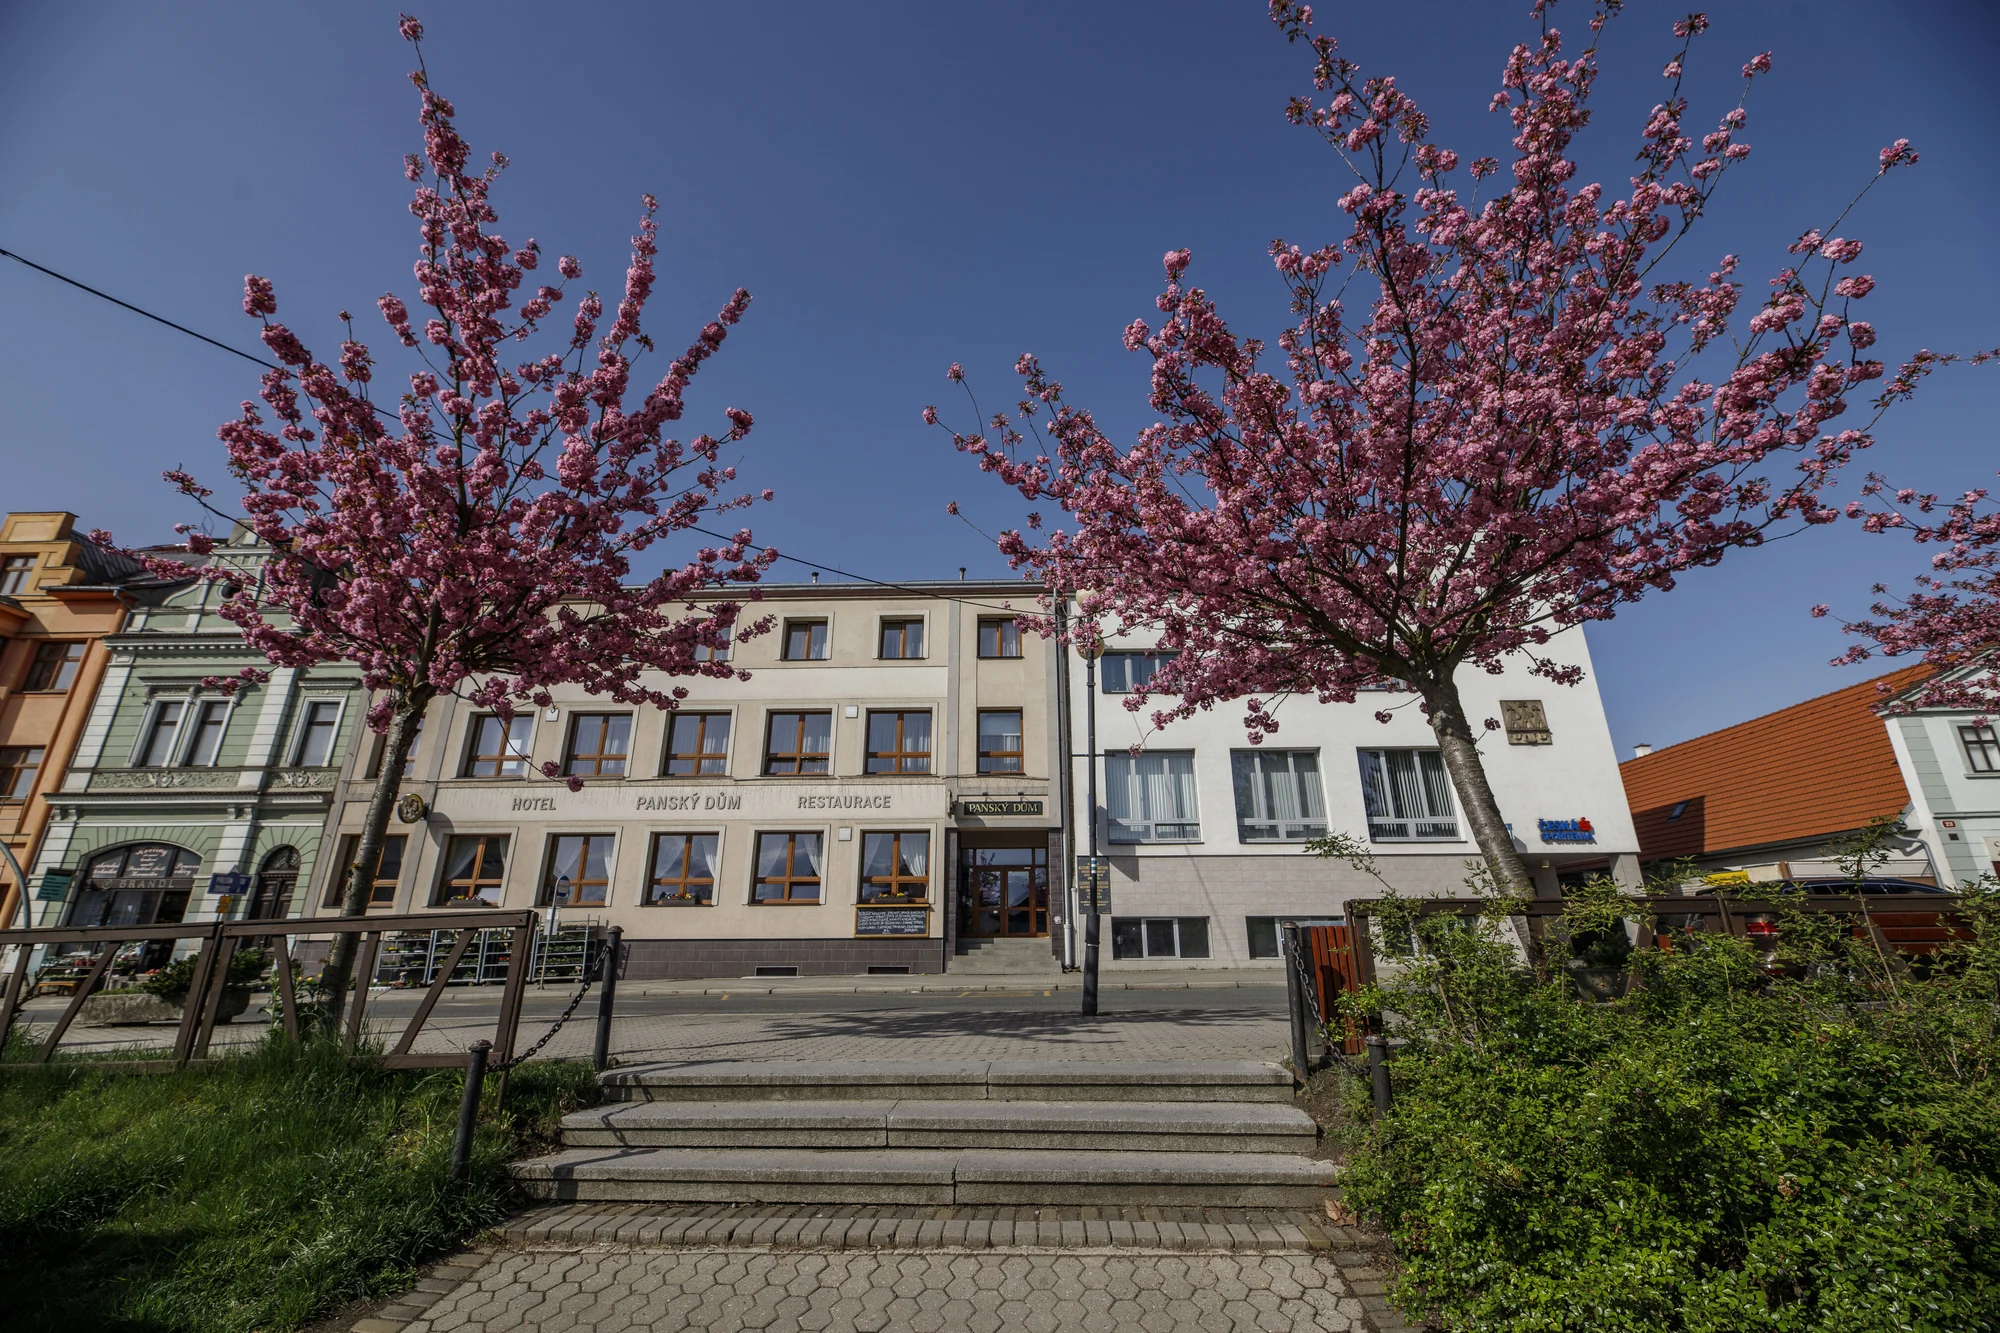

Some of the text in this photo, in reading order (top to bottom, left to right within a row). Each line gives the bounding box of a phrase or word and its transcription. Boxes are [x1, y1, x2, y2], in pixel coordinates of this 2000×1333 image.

[512, 797, 557, 811] HOTEL
[635, 792, 742, 811] PANSKÝ DŮM
[797, 795, 892, 809] RESTAURACE
[968, 801, 1038, 813] PANSKÝ DŮM
[1538, 818, 1580, 831] ČESKÁ
[1540, 831, 1594, 841] SPOŘITELNA
[119, 880, 174, 889] BRANDL
